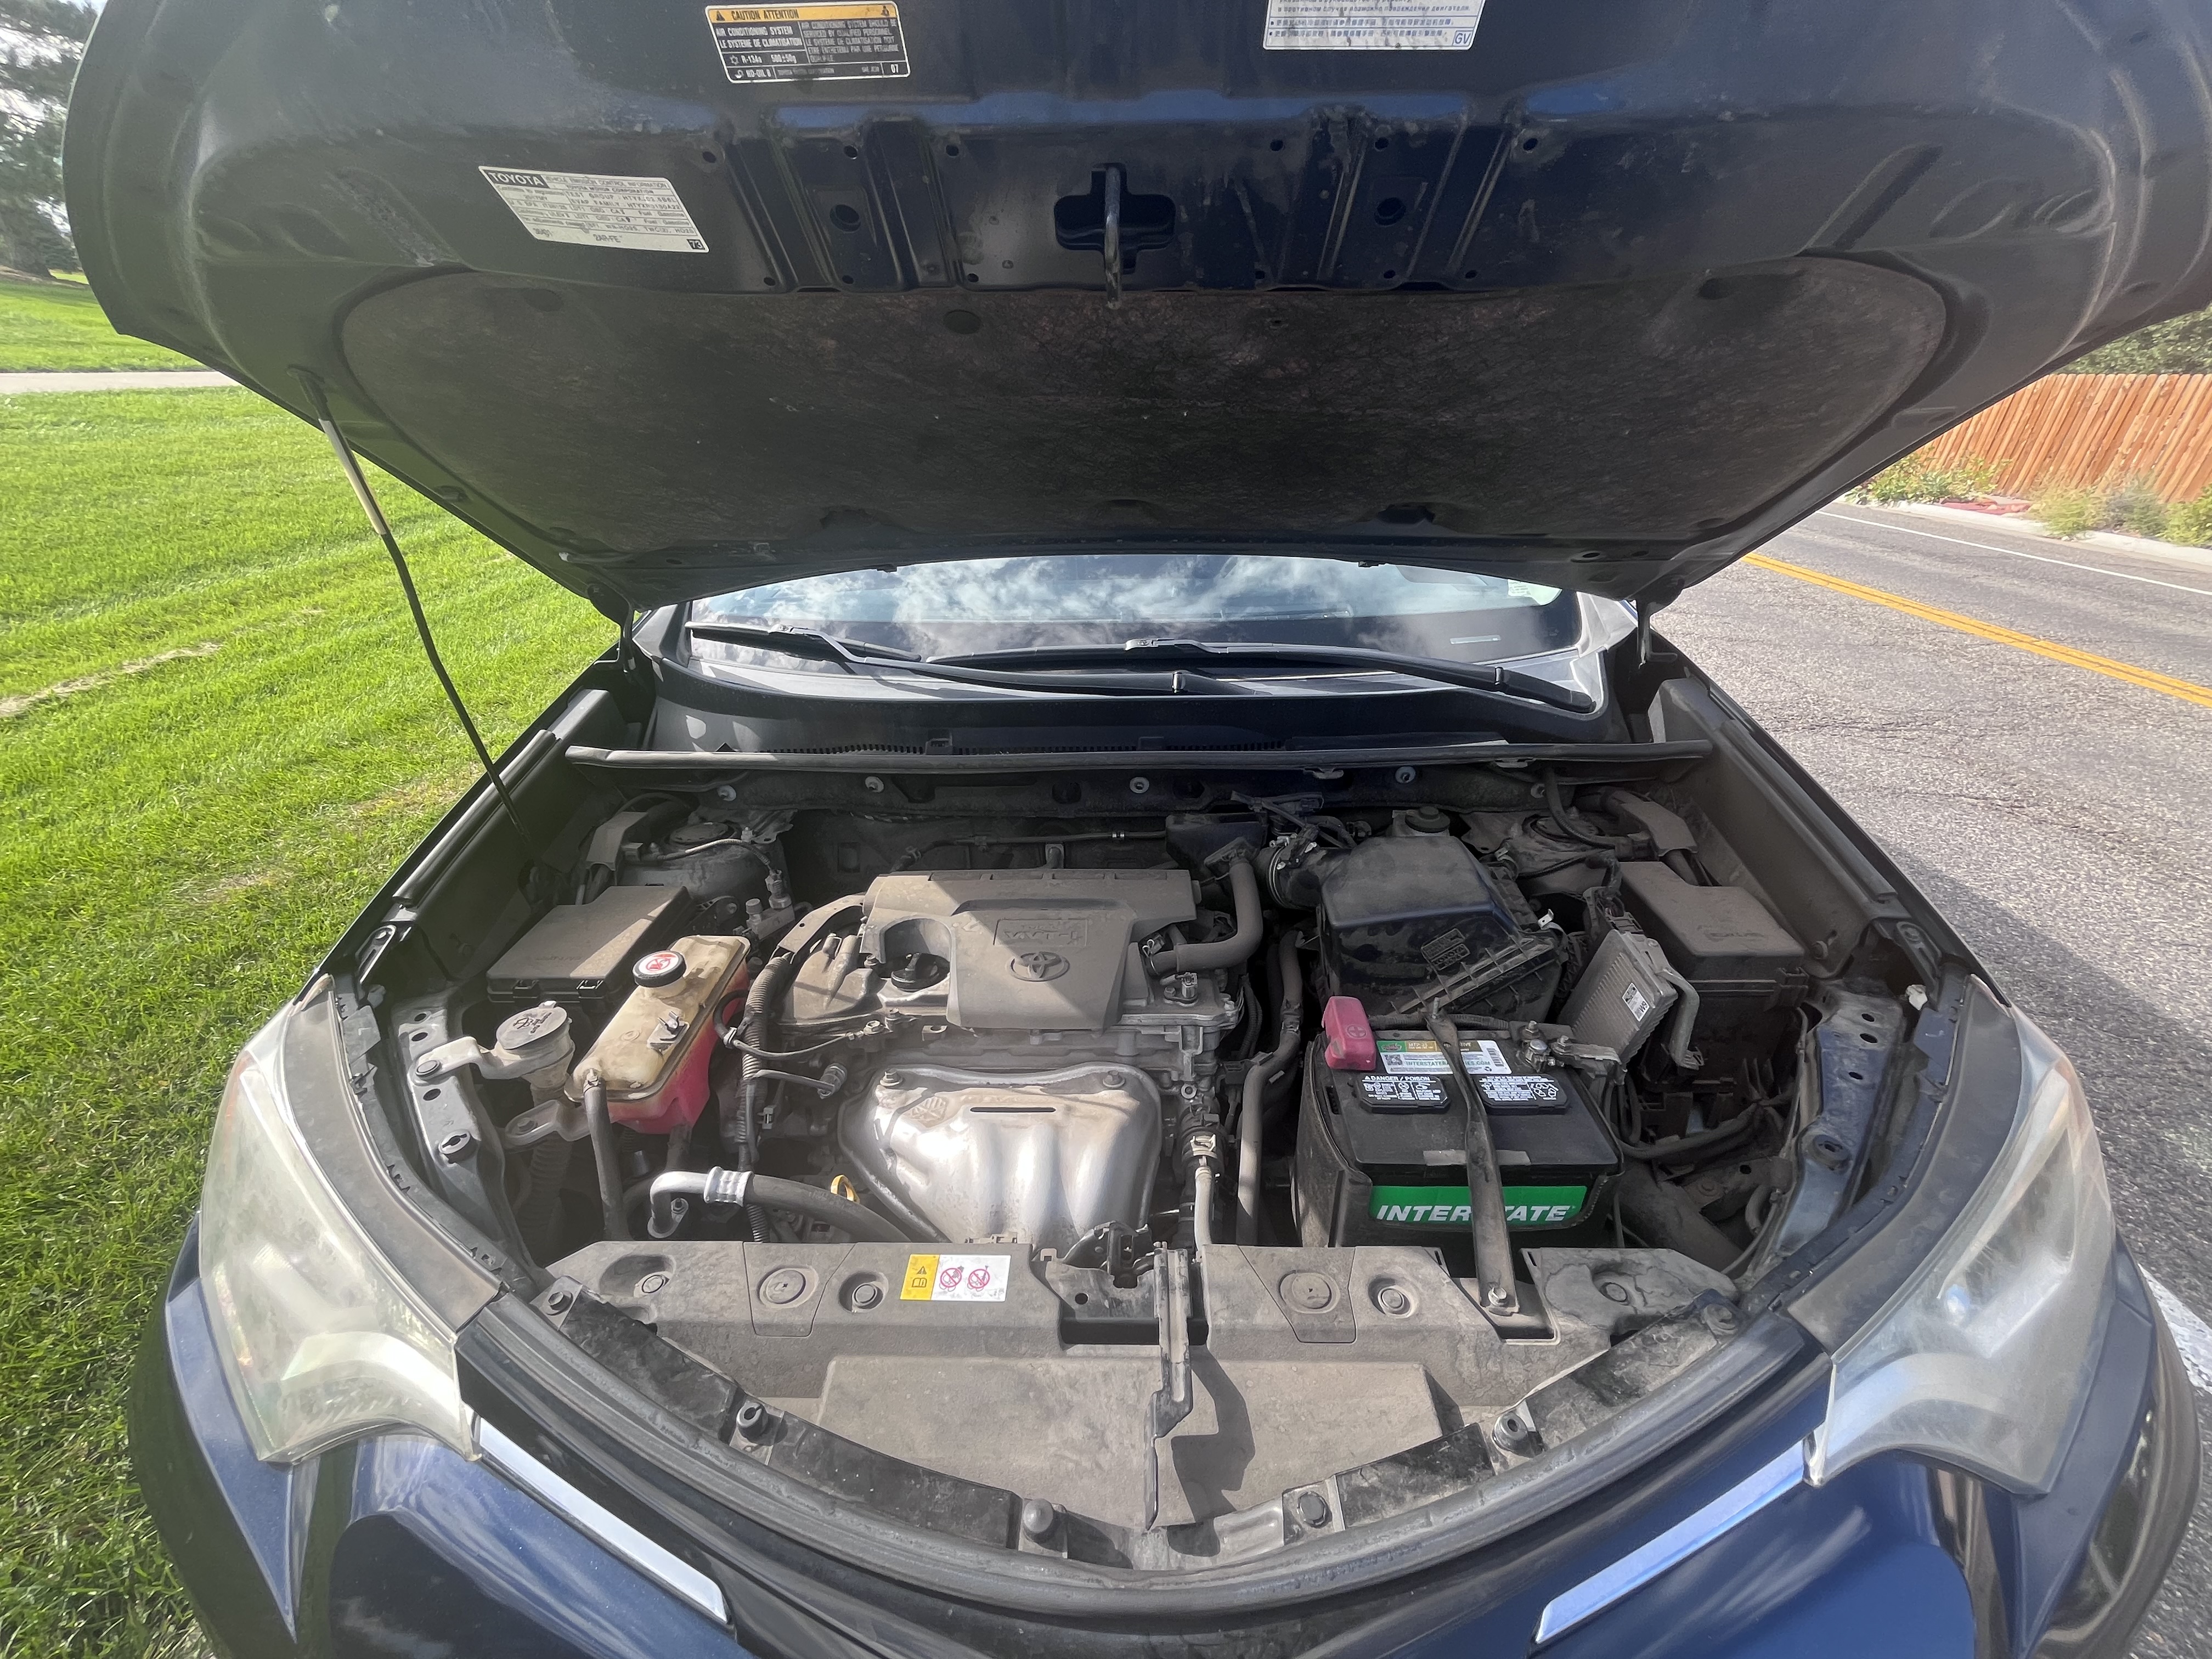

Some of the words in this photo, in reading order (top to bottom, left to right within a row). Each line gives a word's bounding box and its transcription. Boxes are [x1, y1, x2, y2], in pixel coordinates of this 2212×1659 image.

[731, 11, 761, 20] CAUTION
[763, 9, 799, 20] ATTENTION
[716, 27, 726, 36] AIR
[727, 26, 768, 36] CONDITIONING
[769, 26, 793, 35] SYSTEM
[719, 40, 727, 48] LE
[753, 38, 761, 48] DE
[761, 37, 803, 47] CLIMATISATION
[1455, 32, 1471, 44] GV
[741, 55, 763, 64] R-134a
[890, 64, 899, 74] 07
[488, 172, 544, 186] TOYOTA
[690, 241, 702, 250] 73
[1376, 1205, 1571, 1222] INTERATE
